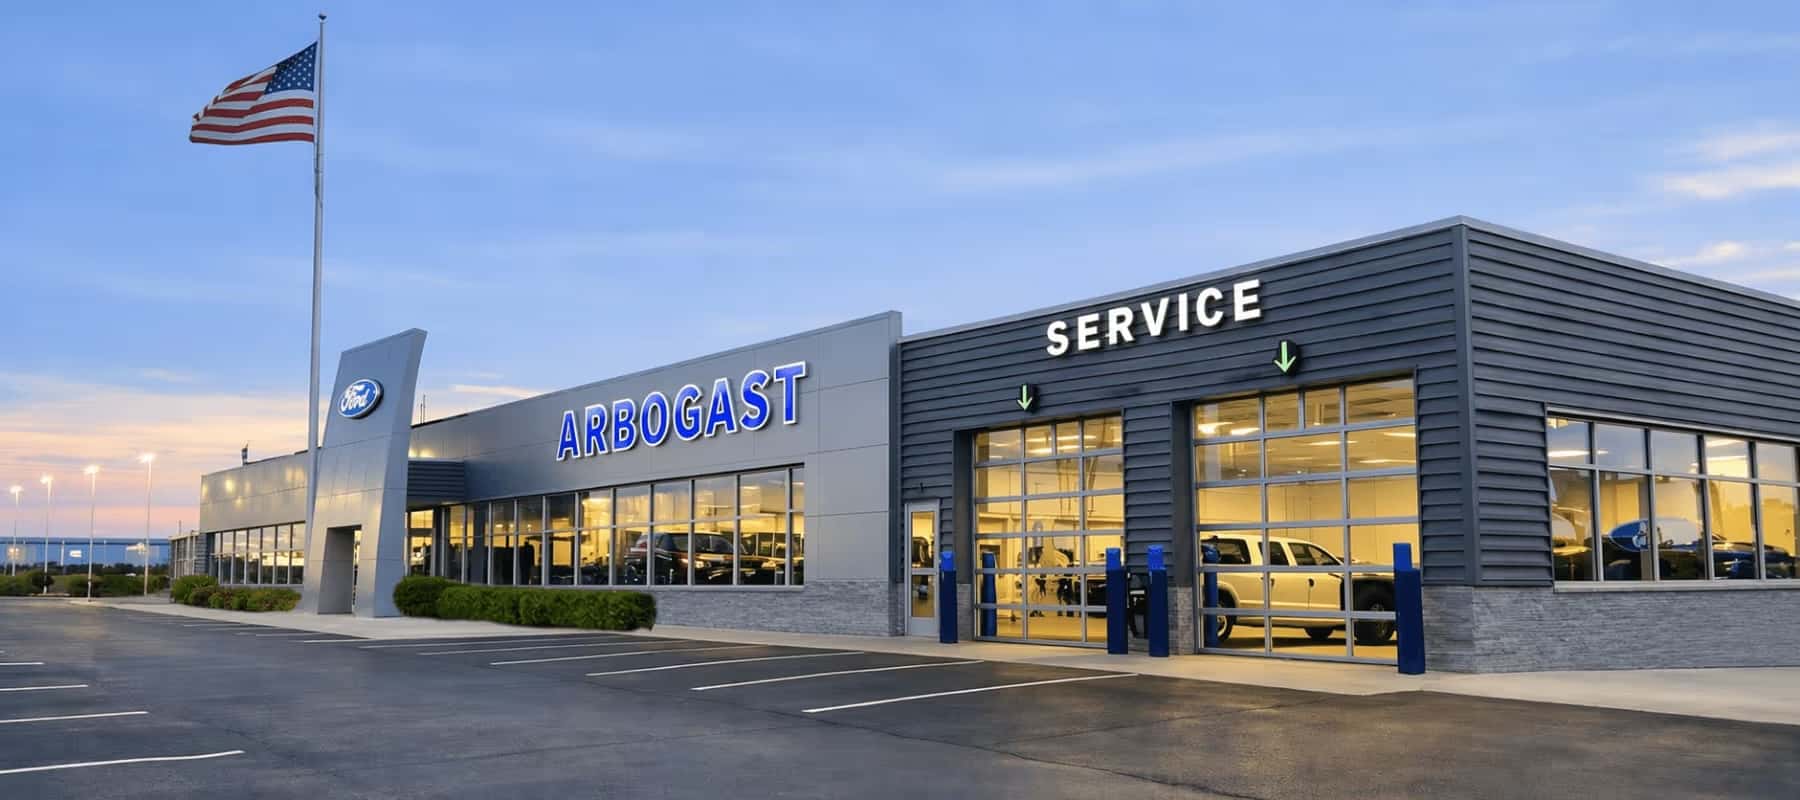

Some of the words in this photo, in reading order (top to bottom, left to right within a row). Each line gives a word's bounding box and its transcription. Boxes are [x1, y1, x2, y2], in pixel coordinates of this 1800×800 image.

[1046, 279, 1262, 357] SERVICE
[341, 384, 370, 412] Ford
[556, 360, 806, 461] ARBOGAST
